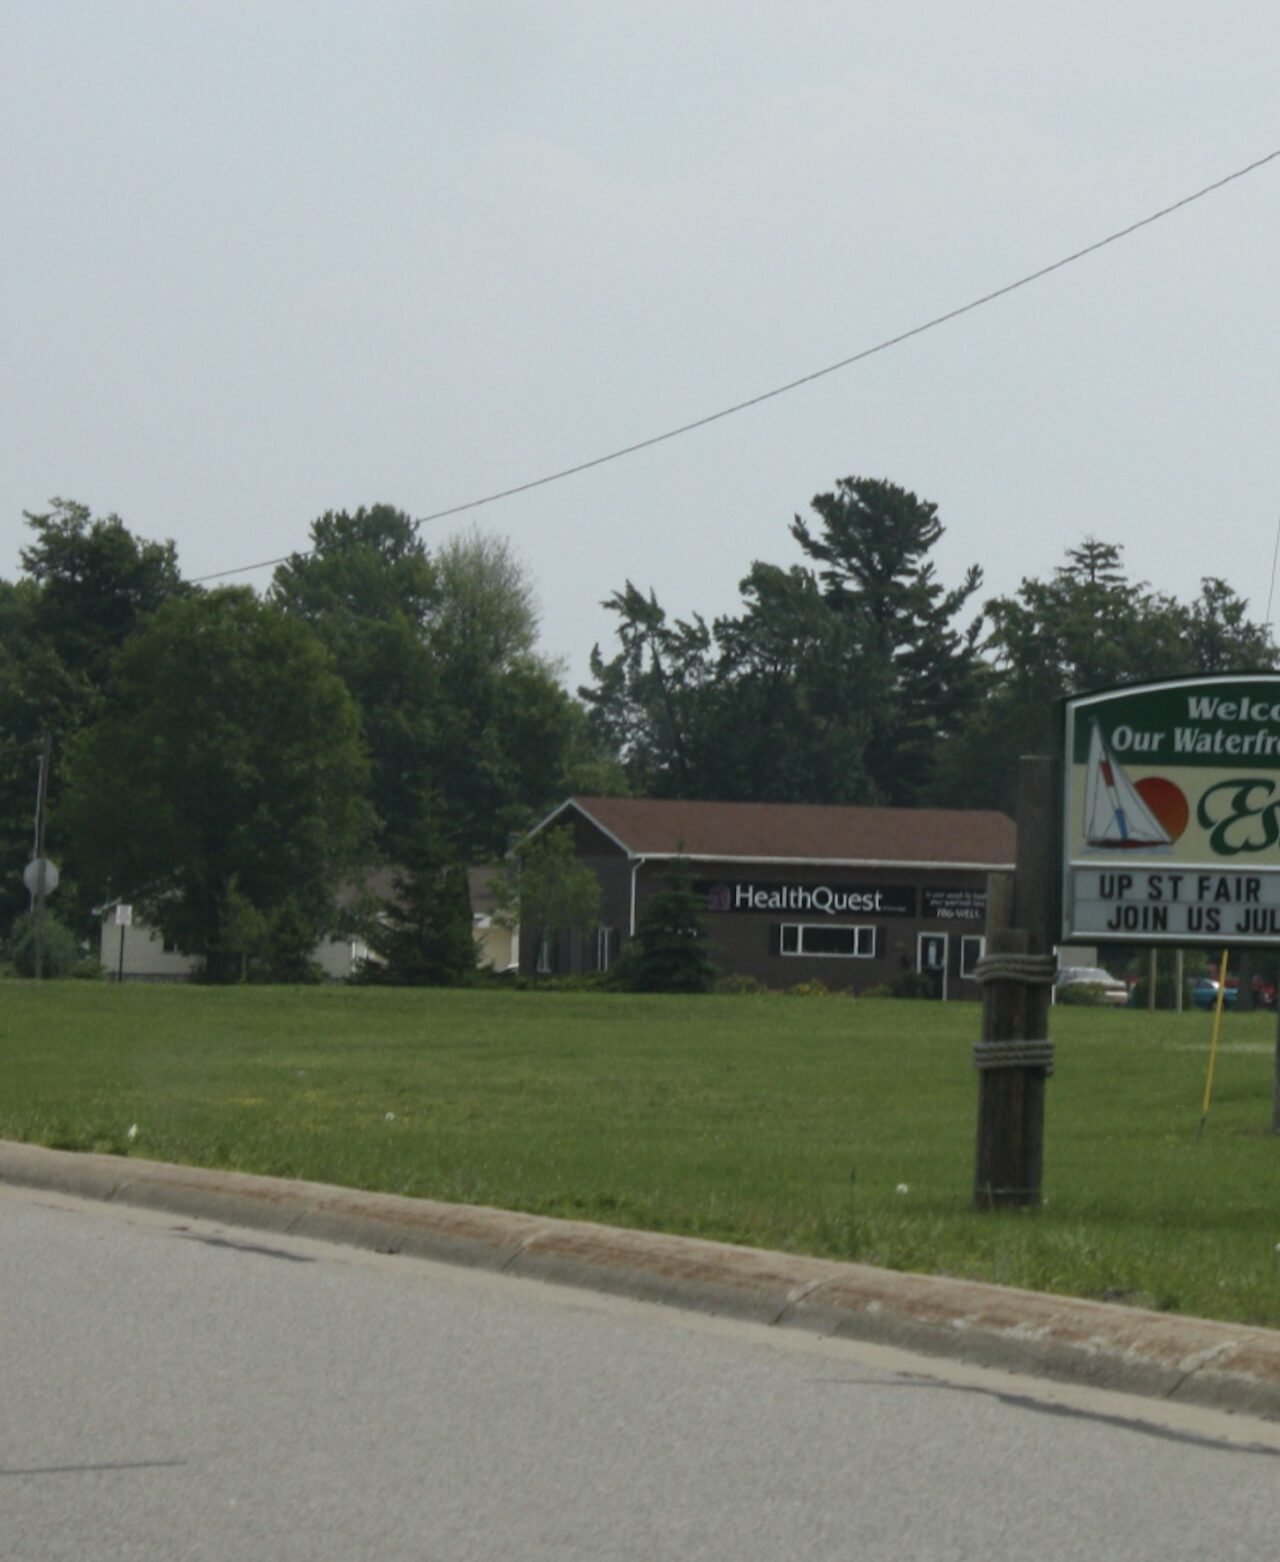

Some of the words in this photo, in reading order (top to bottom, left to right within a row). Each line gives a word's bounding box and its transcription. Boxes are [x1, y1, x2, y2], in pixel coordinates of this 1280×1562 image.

[1110, 725, 1164, 752] Our
[734, 884, 883, 915] HealthQuest
[1099, 874, 1133, 901] UP
[1147, 875, 1183, 902] ST
[1197, 876, 1260, 902] FAIR
[1106, 905, 1168, 933] JOIN
[1187, 907, 1220, 934] US
